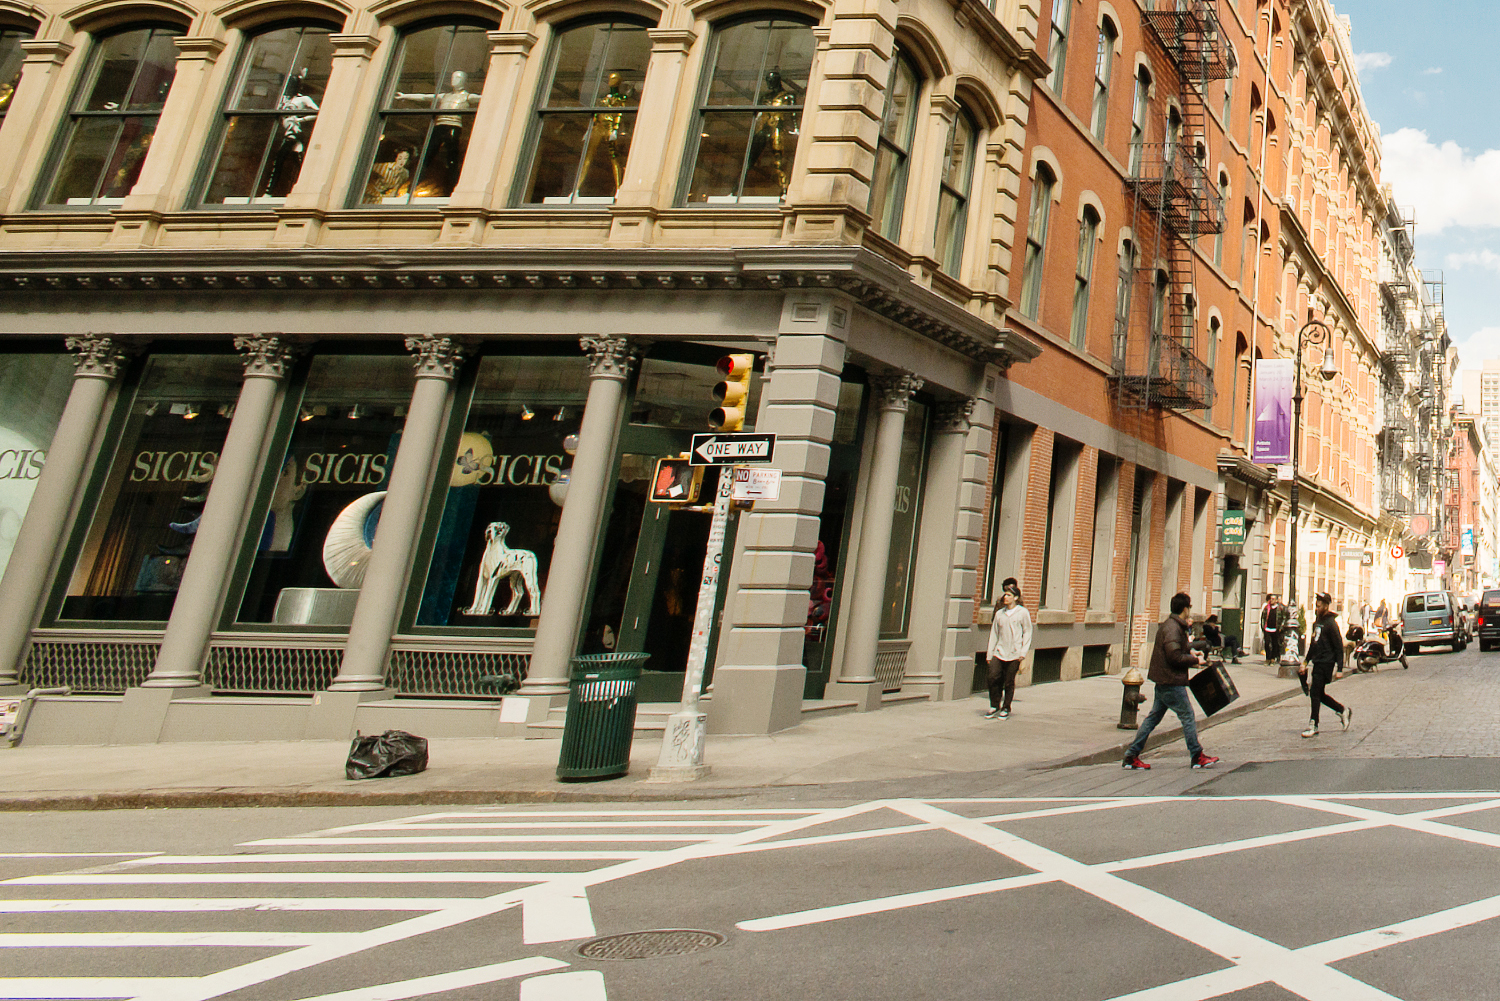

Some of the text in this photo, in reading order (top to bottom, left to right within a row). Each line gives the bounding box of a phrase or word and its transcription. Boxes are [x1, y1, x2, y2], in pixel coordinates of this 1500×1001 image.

[707, 443, 763, 455] ONE WAY
[129, 451, 220, 482] SICIS
[300, 453, 389, 484] SICIS
[474, 453, 563, 486] SICIS
[736, 470, 778, 481] NO PARKING
